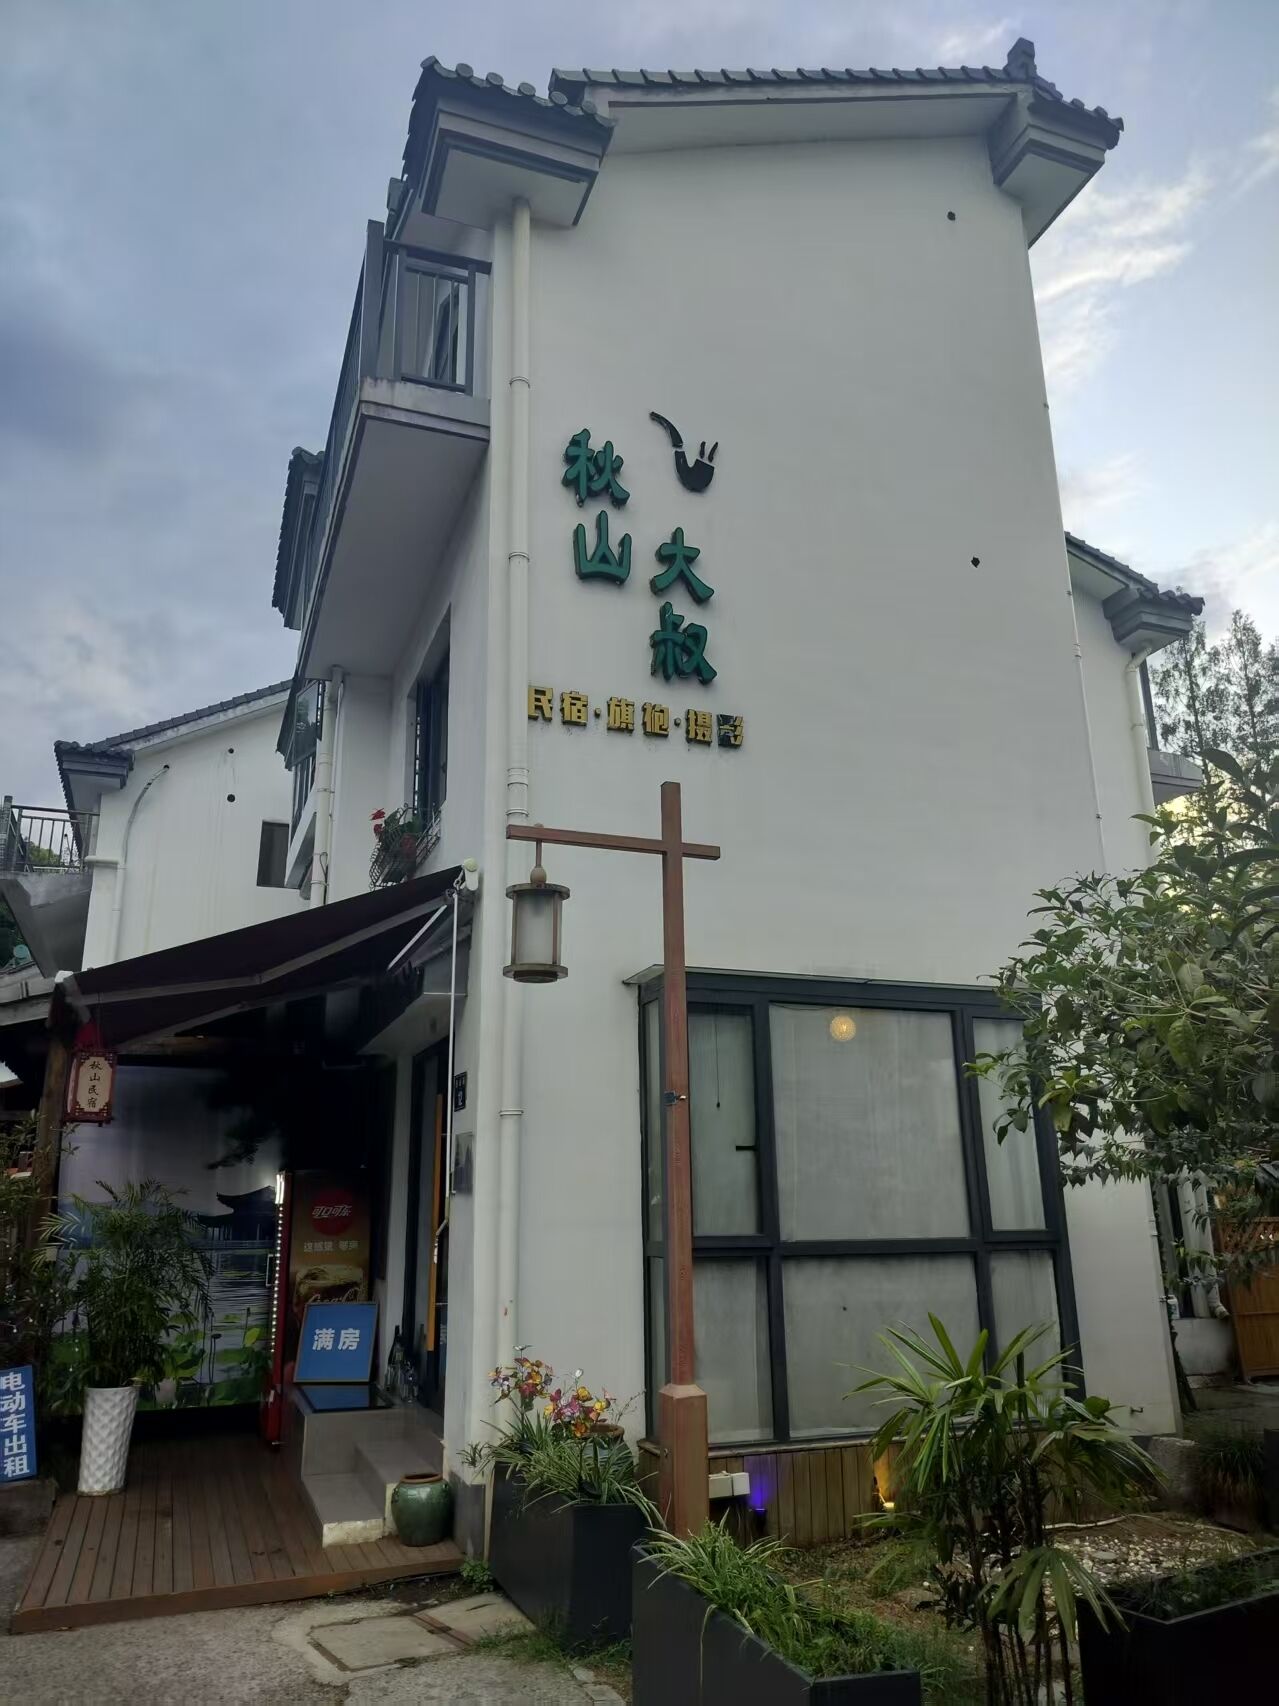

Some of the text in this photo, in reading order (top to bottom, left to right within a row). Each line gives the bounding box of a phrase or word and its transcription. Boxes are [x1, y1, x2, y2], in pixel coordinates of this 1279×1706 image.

[561, 428, 631, 585] 秋山
[650, 527, 718, 685] 大叔
[88, 1060, 103, 1108] 秋山民宿
[312, 1328, 361, 1351] 满房
[0, 1371, 30, 1478] 电动车出租
